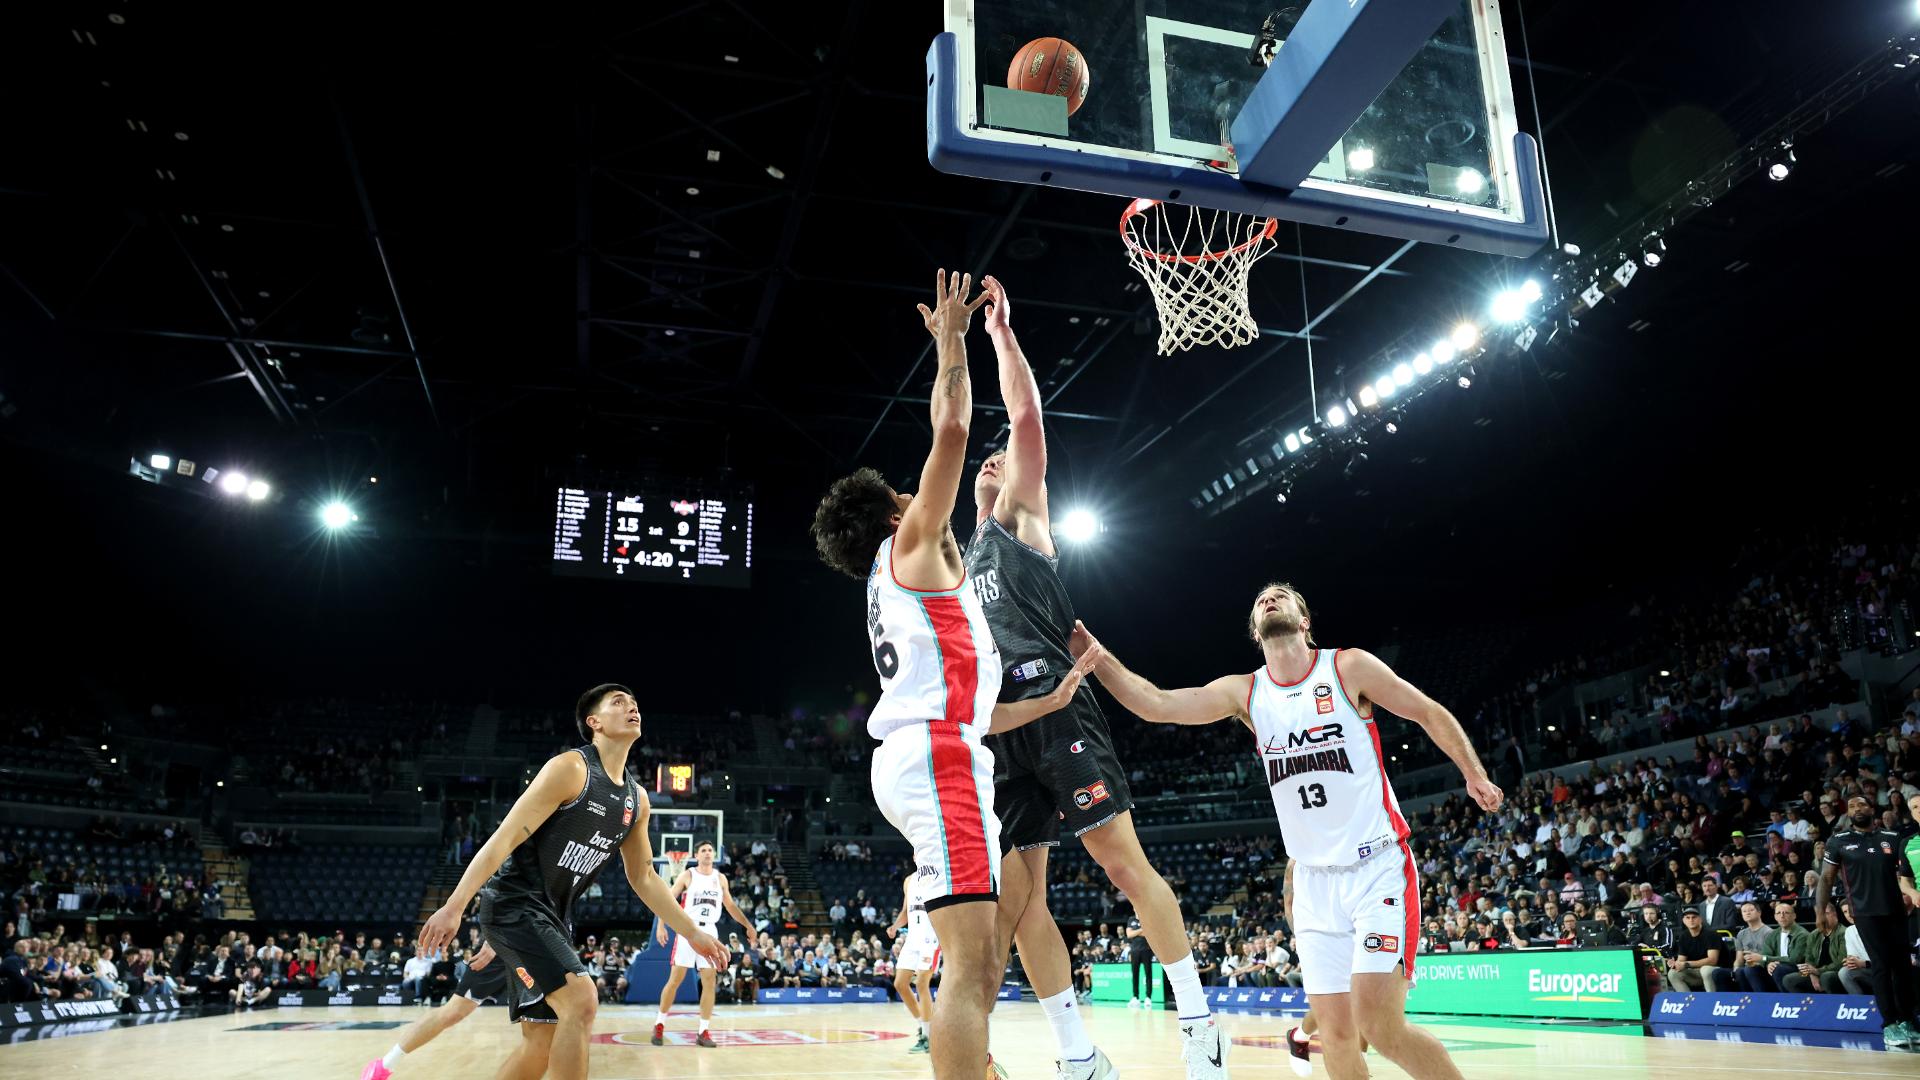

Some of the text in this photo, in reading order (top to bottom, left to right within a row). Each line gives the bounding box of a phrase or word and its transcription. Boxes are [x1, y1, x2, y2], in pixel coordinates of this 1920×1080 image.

[617, 516, 639, 532] 15
[648, 526, 663, 535] 1st
[677, 521, 690, 536] 9
[634, 550, 673, 567] 4:20
[616, 564, 624, 574] 1
[683, 568, 690, 578] 1
[874, 622, 899, 680] 6
[1288, 723, 1345, 748] MCR
[1268, 747, 1354, 787] ILLAWARRA
[1297, 782, 1328, 810] 13
[589, 831, 613, 850] bnz
[701, 908, 709, 917] 21
[1429, 965, 1465, 980] DRIVE
[1466, 963, 1500, 980] WITH
[1528, 969, 1622, 1001] Europcar
[1660, 998, 1684, 1014] bnz
[1712, 1000, 1739, 1017] bnz
[1771, 1003, 1800, 1019] bnz
[1836, 1003, 1868, 1020] bnz
